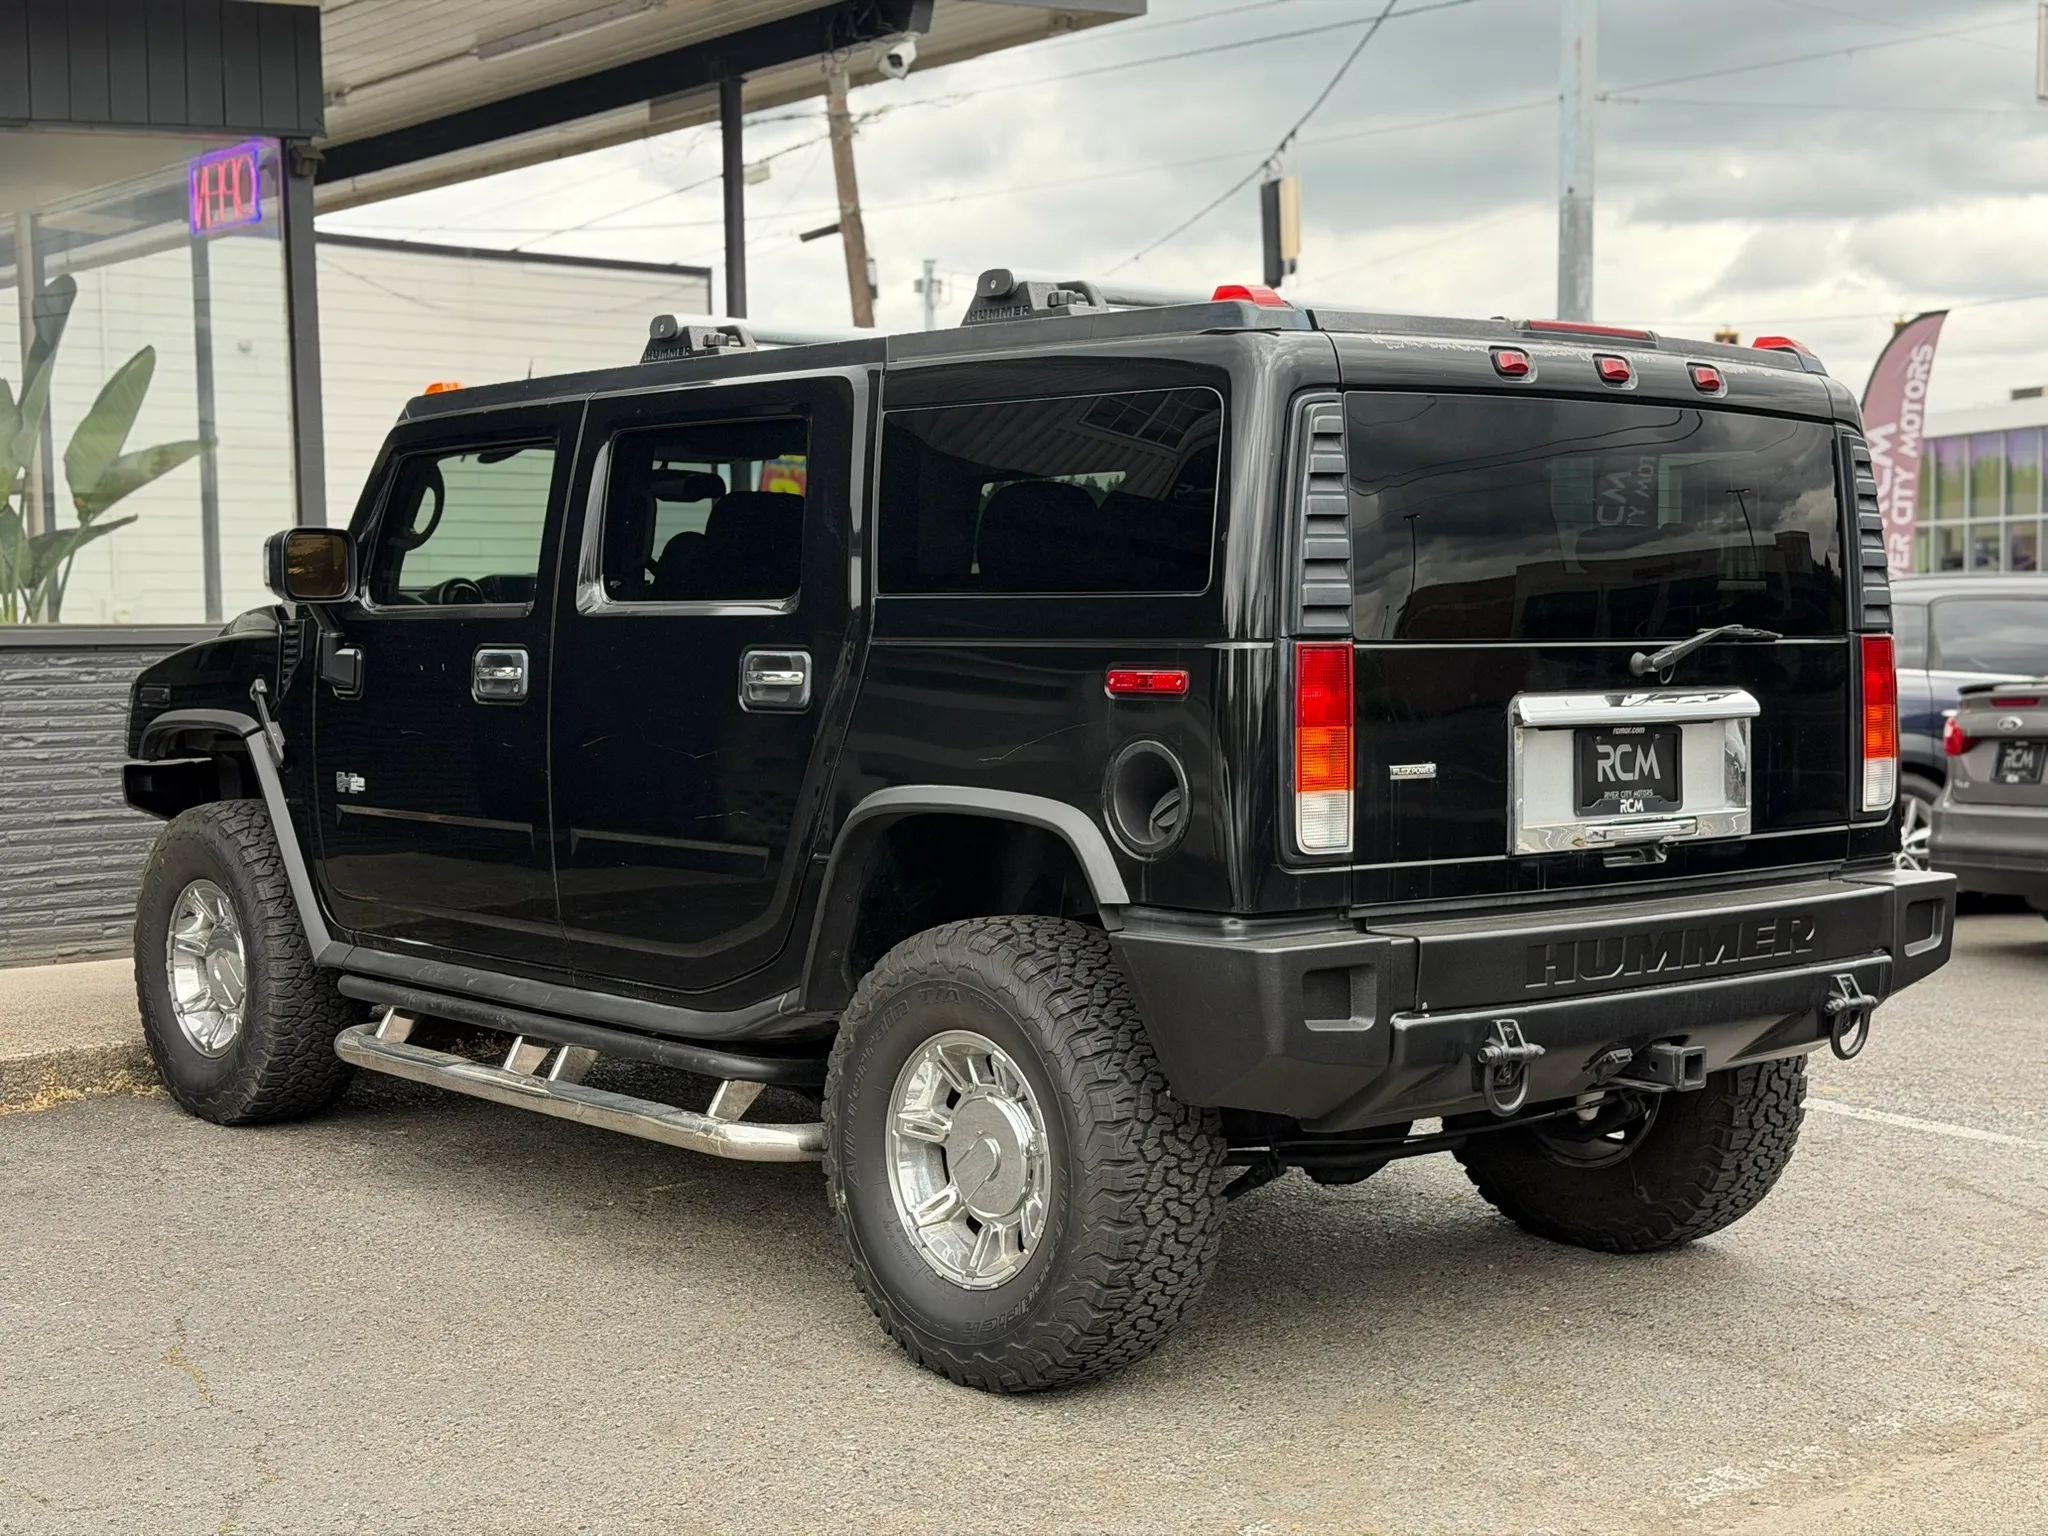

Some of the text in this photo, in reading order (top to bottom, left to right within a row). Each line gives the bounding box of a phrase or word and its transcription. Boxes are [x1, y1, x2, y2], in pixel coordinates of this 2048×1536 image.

[965, 305, 1031, 322] HUMMER
[1899, 343, 1934, 459] MOTORS
[1597, 471, 1632, 527] CM
[1891, 466, 1916, 525] CITY
[1596, 743, 1661, 782] RCM
[2003, 749, 2034, 769] RCM
[336, 771, 365, 793] H2
[1604, 788, 1654, 800] RIVER CITY MOTORS
[1620, 798, 1645, 813] RCM
[1525, 919, 1815, 988] HUMMER
